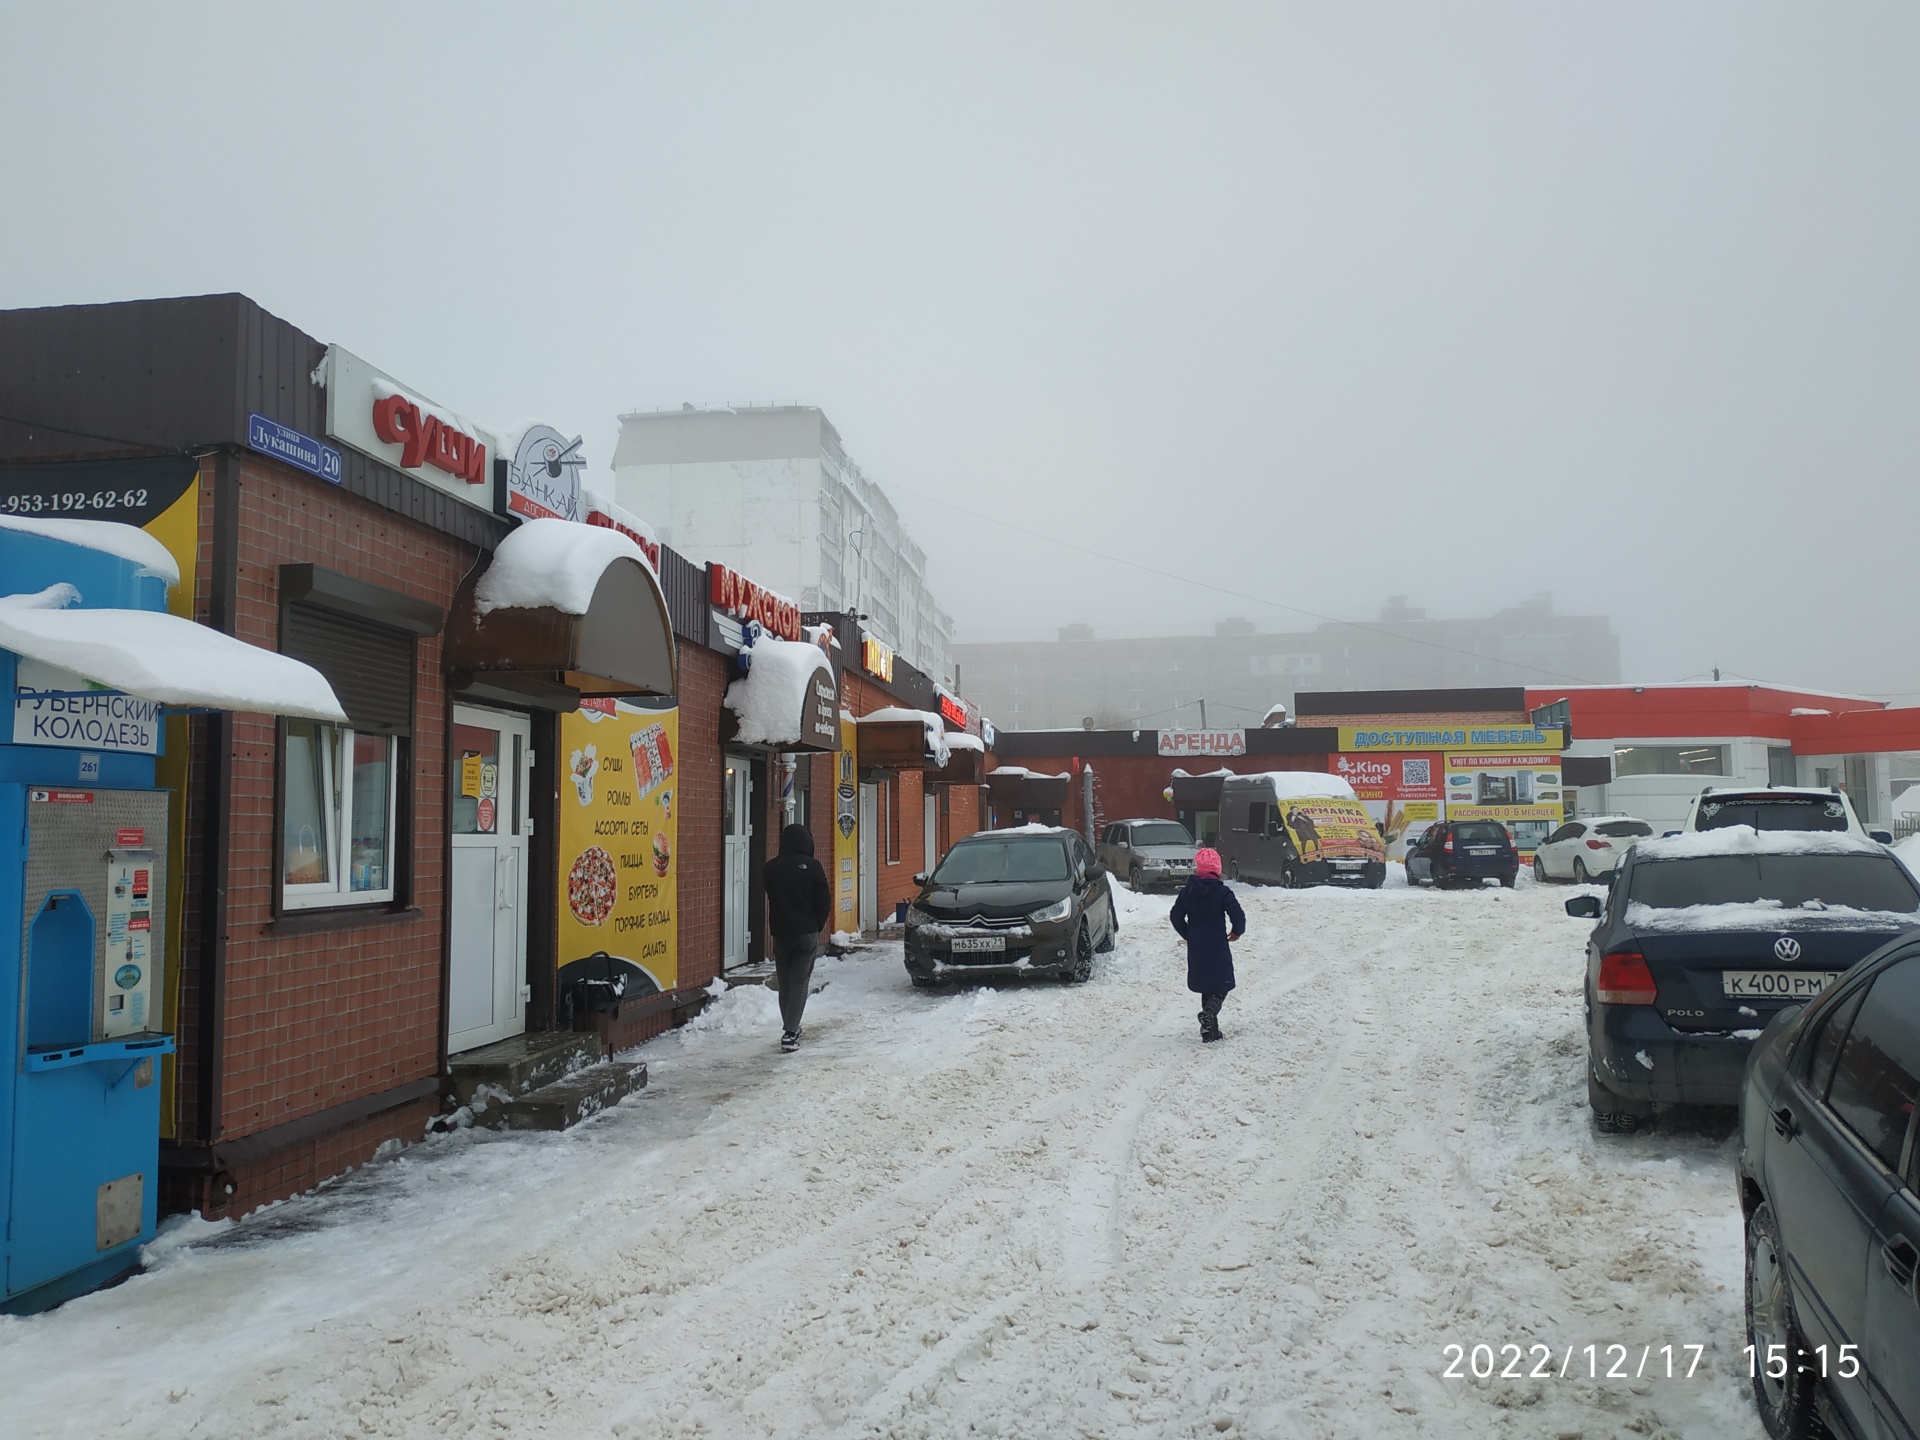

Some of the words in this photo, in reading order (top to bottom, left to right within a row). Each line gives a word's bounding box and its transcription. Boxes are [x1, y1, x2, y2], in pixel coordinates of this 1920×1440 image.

[276, 427, 300, 443] улица
[253, 425, 317, 465] Лукашина
[323, 452, 339, 476] 20
[0, 489, 148, 513] -953-192-62-62
[711, 564, 801, 642] МУЖСКОЙ
[34, 715, 149, 747] КОЛОДЕЗЬ
[1354, 730, 1465, 748] ДОСТУПНАЯ
[1470, 729, 1546, 744] МЕБЕЛЬ
[1159, 733, 1245, 752] АРЕНДА
[82, 762, 98, 772] 261
[602, 757, 623, 773] СУШИ
[1356, 761, 1391, 776] King
[1479, 757, 1512, 765] КАРМАНУ
[1512, 756, 1551, 765] КАЖДОМУ!
[606, 790, 632, 806] РОЛЛЫ
[1302, 807, 1364, 817] ЯРМАРКА
[1454, 809, 1493, 817] РАССРОЧКА
[1521, 808, 1555, 817] МЕСЯЦЕВ
[594, 821, 629, 836] АССОРТИ
[631, 820, 649, 835] СЕТЫ
[1337, 816, 1368, 826] ШУБ
[620, 853, 643, 869] ПИЦЦА
[628, 883, 658, 901] БУРГЕРЫ
[614, 914, 646, 934] ГОРЯЧИЕ
[648, 909, 671, 927] БЛЮДА
[642, 940, 667, 959] САЛАТЫ
[1667, 1009, 1705, 1017] POLO
